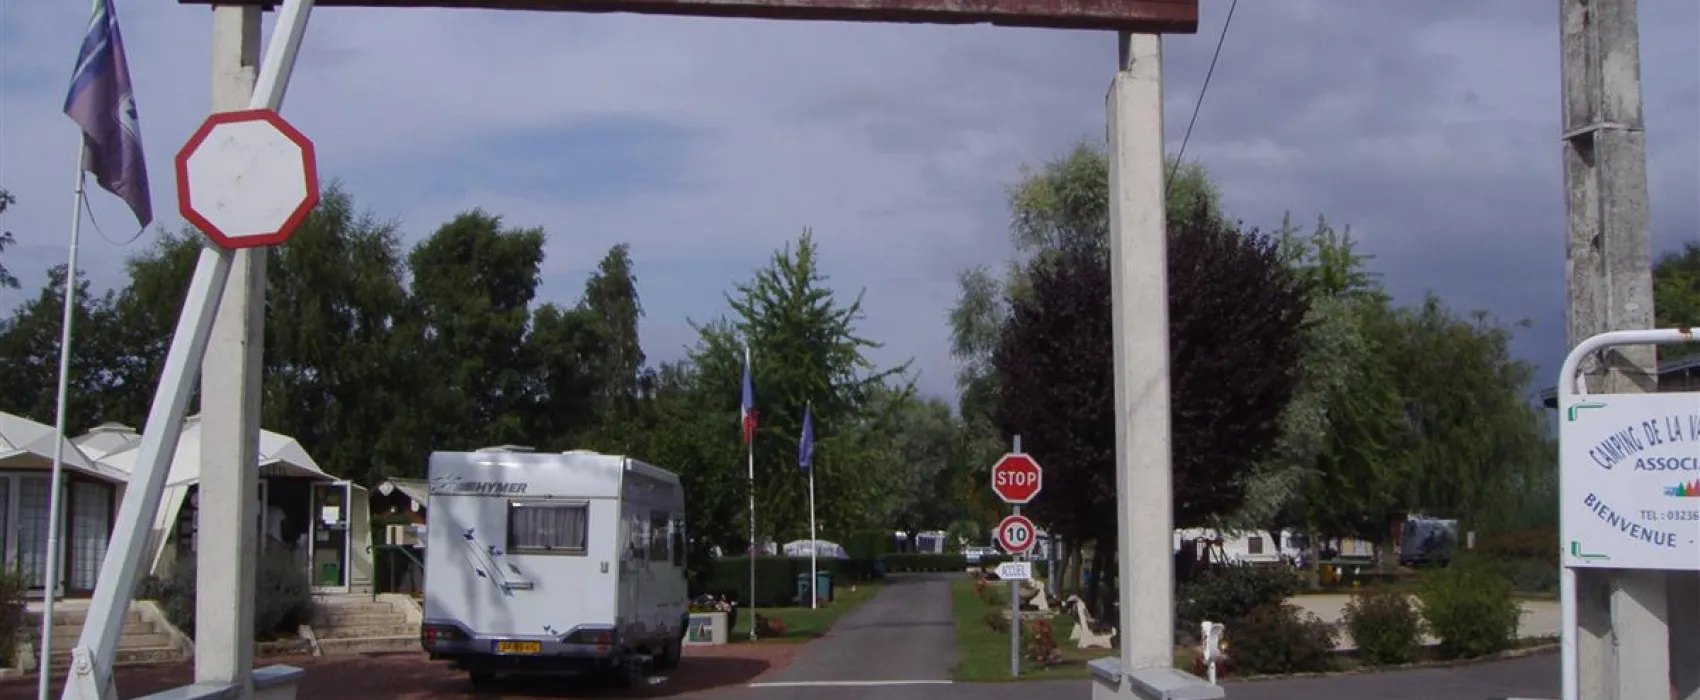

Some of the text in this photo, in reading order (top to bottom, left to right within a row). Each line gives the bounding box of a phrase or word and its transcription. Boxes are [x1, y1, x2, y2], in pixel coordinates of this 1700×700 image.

[1589, 426, 1644, 470] CAMPING
[1642, 419, 1663, 446] DE
[1665, 415, 1684, 442] LA
[1634, 457, 1700, 471] ASSOCI
[997, 471, 1037, 487] STOP
[475, 481, 528, 494] HYMER
[1583, 492, 1677, 548] BIENVENUE
[1640, 509, 1657, 521] TEL
[1667, 509, 1700, 521] 03236
[1006, 526, 1027, 542] 10
[1001, 564, 1027, 577] ACCUEIL
